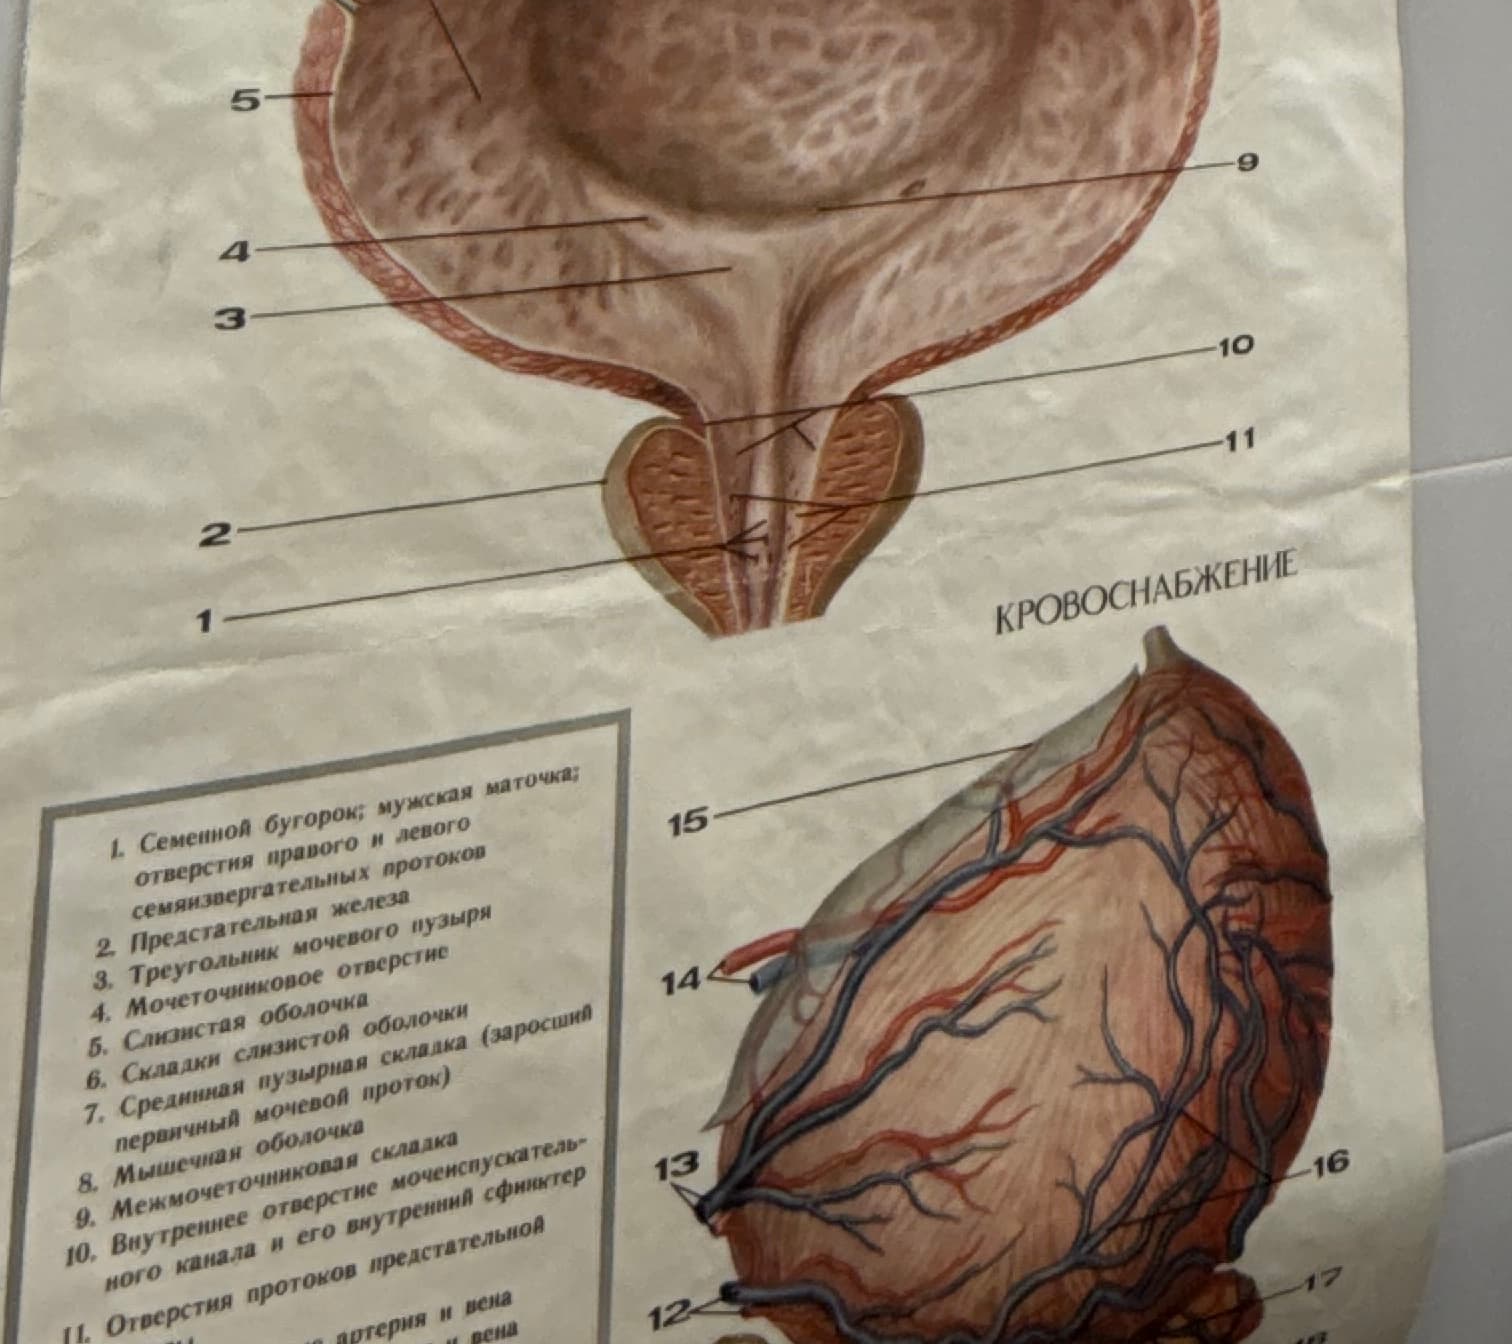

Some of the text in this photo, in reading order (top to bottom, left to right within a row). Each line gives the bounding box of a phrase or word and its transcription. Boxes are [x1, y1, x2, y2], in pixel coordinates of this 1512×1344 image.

[230, 88, 261, 112] 5
[1237, 153, 1259, 172] 9
[219, 241, 251, 263] 4
[213, 306, 247, 331] 3
[1217, 334, 1256, 356] 10
[1224, 427, 1257, 454] 11
[198, 522, 232, 548] 2
[995, 547, 1299, 637] КРОВОСНАБЖЕНИЕ
[196, 610, 212, 633] 1
[111, 765, 579, 859] 1. Семенной бугорок; мужская маточка;
[667, 807, 710, 837] 15
[135, 816, 470, 887] отверстия правого и левого
[132, 845, 486, 920] семяизвергательных протоков
[94, 904, 492, 990] 3. Треугольник мочевого пузыря
[96, 890, 410, 958] 2. Предстательная железа
[92, 945, 449, 1023] 4. Мочеточниковое отверстие
[661, 966, 702, 995] 14
[86, 1003, 468, 1090] 6. Складки слизистой оболочки
[88, 993, 368, 1057] 5. Слизистая оболочка
[85, 1002, 593, 1125] 7. Срединная пузырная складка (заросший
[115, 1065, 450, 1153] первичный мочевой проток)
[76, 1131, 458, 1229] 9. Межмочеточниковая складка
[78, 1119, 364, 1194] 8. Мышечная оболочка
[654, 1149, 700, 1181] 13
[1314, 1149, 1350, 1179] 16
[65, 1136, 587, 1268] 10. Внутреннее отверстие мочеиспускатель-
[105, 1166, 587, 1292] ного канала и его внутренний сфинктер
[106, 1293, 233, 1338] Отверстия
[247, 1263, 356, 1305] протоков
[369, 1215, 545, 1276] предстательной
[1306, 1266, 1343, 1292] 17
[440, 1307, 452, 1321] и
[466, 1290, 513, 1315] вена
[648, 1299, 691, 1332] 12
[471, 1320, 519, 1344] вена
